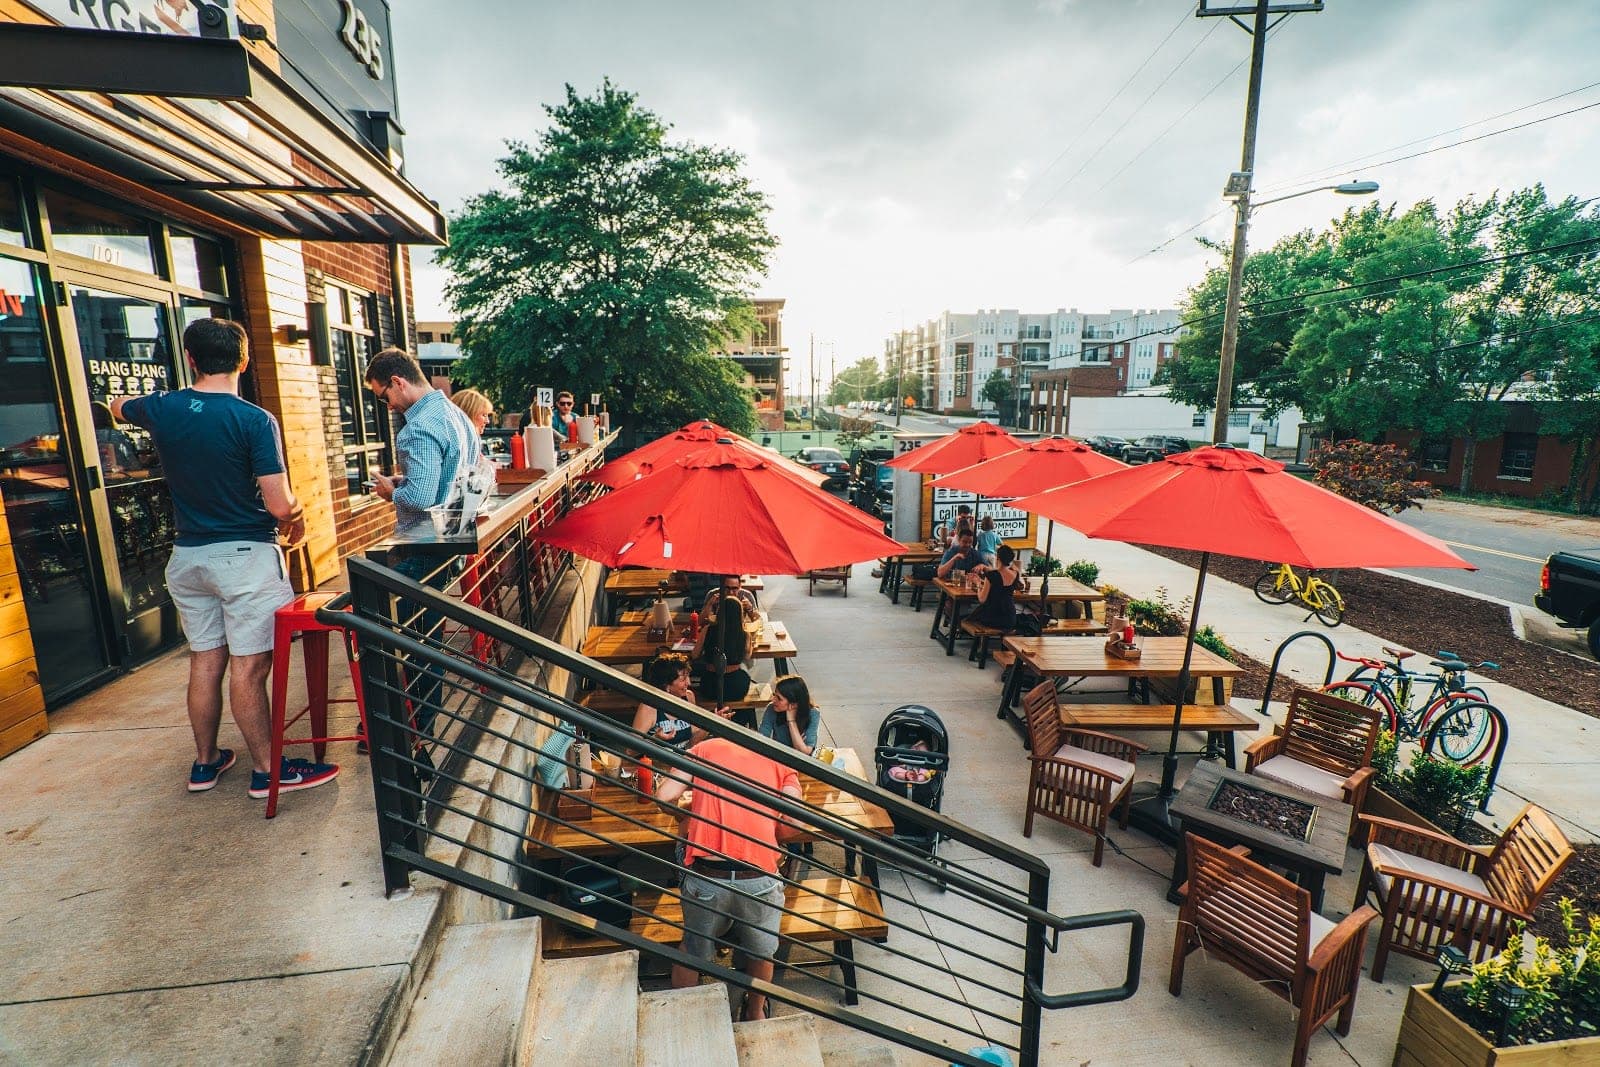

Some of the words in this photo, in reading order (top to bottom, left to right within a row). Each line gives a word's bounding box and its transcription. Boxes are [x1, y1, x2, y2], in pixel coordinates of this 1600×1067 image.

[89, 359, 130, 375] BANG
[131, 363, 167, 378] BANG
[540, 391, 551, 404] 12
